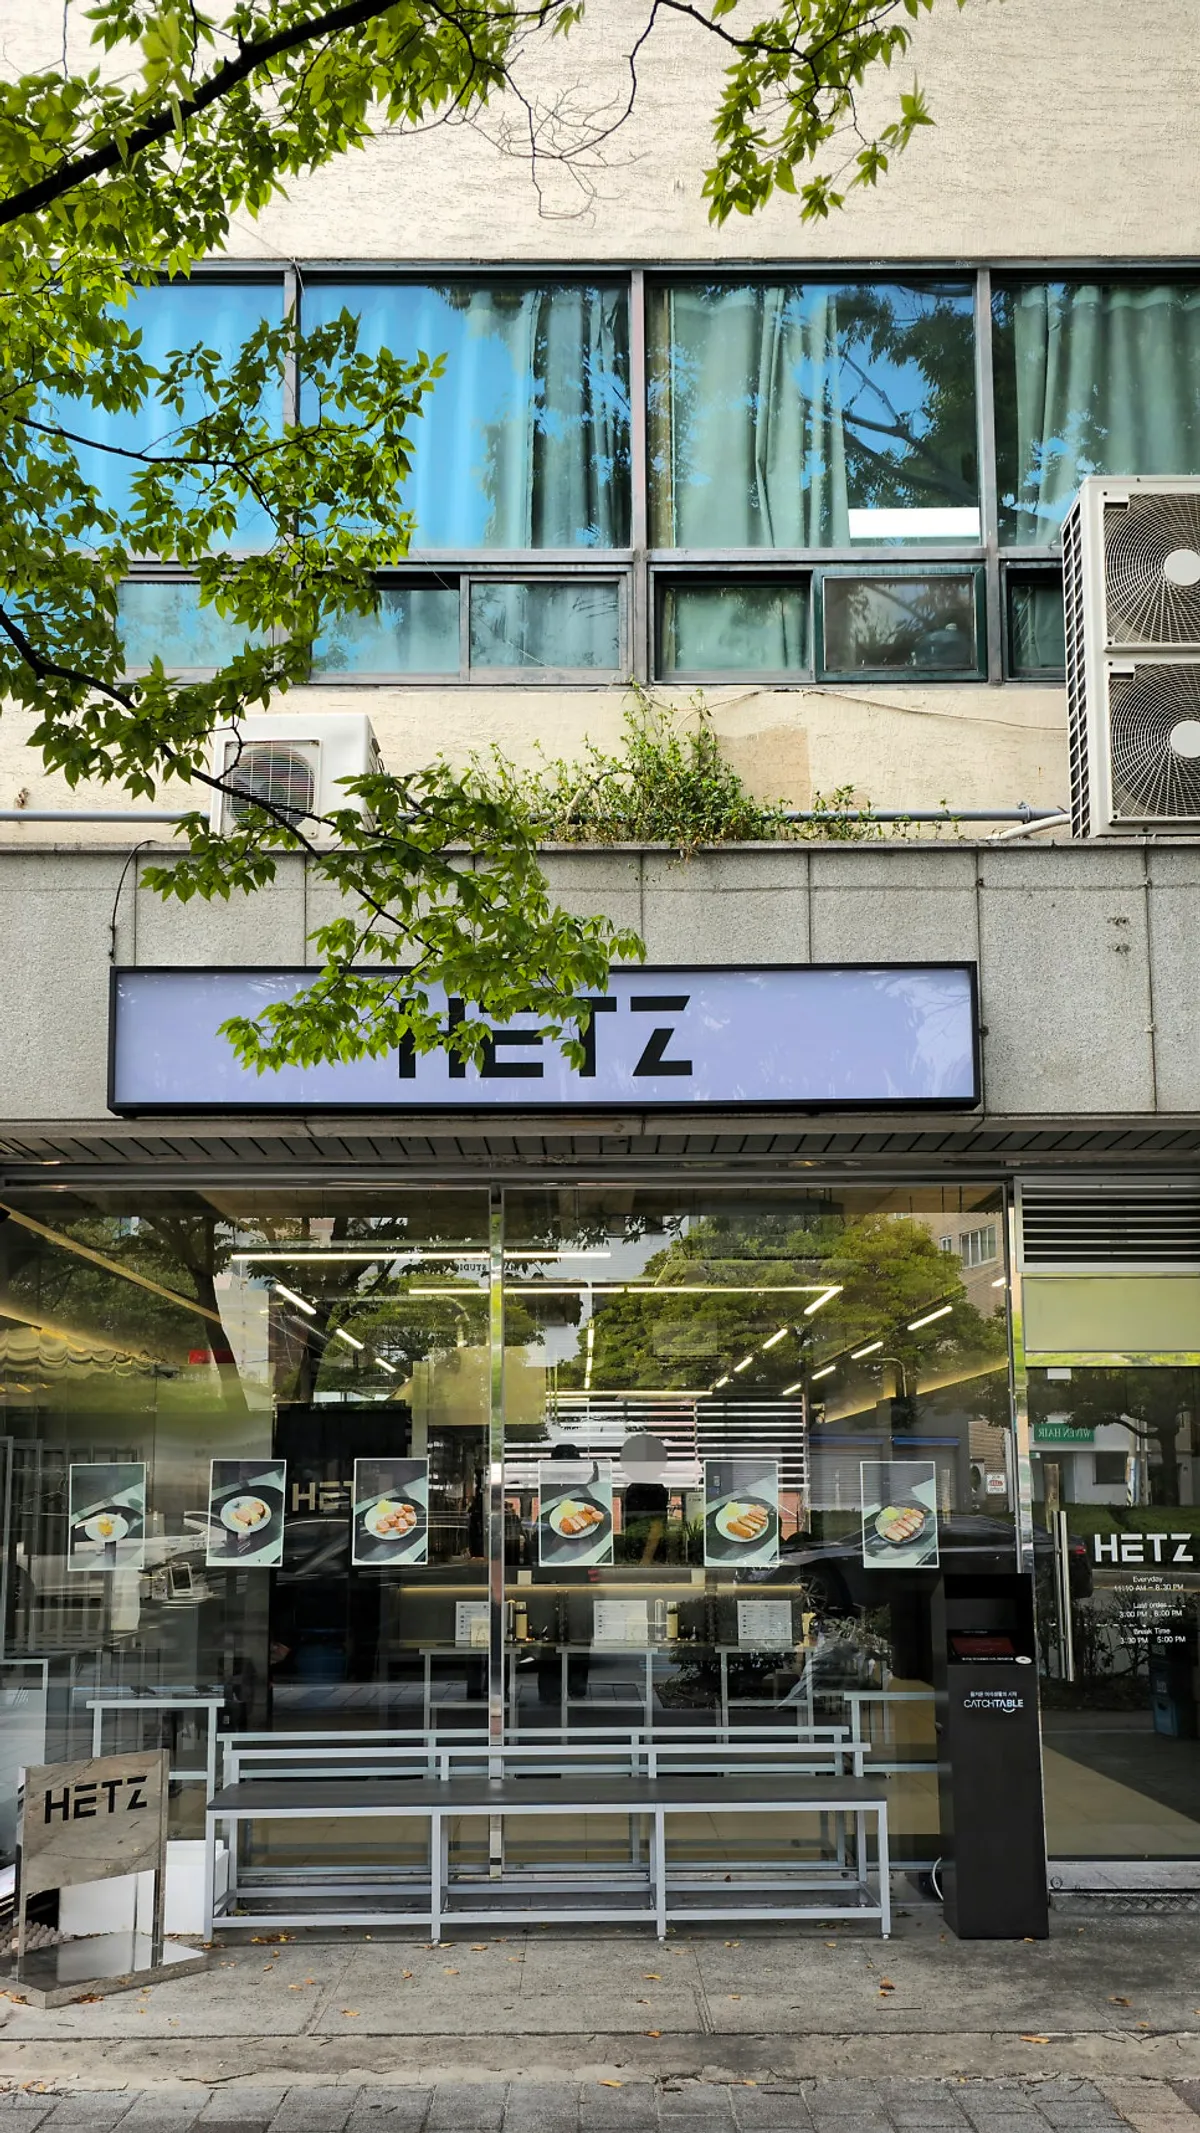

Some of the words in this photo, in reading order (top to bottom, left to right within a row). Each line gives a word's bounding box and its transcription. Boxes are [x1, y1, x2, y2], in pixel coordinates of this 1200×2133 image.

[399, 996, 693, 1079] HETZ
[1094, 1533, 1194, 1562] HETZ
[1133, 1576, 1163, 1584] Everyday
[964, 1699, 1024, 1709] CATCHTABLE
[45, 1776, 148, 1824] HETZ
